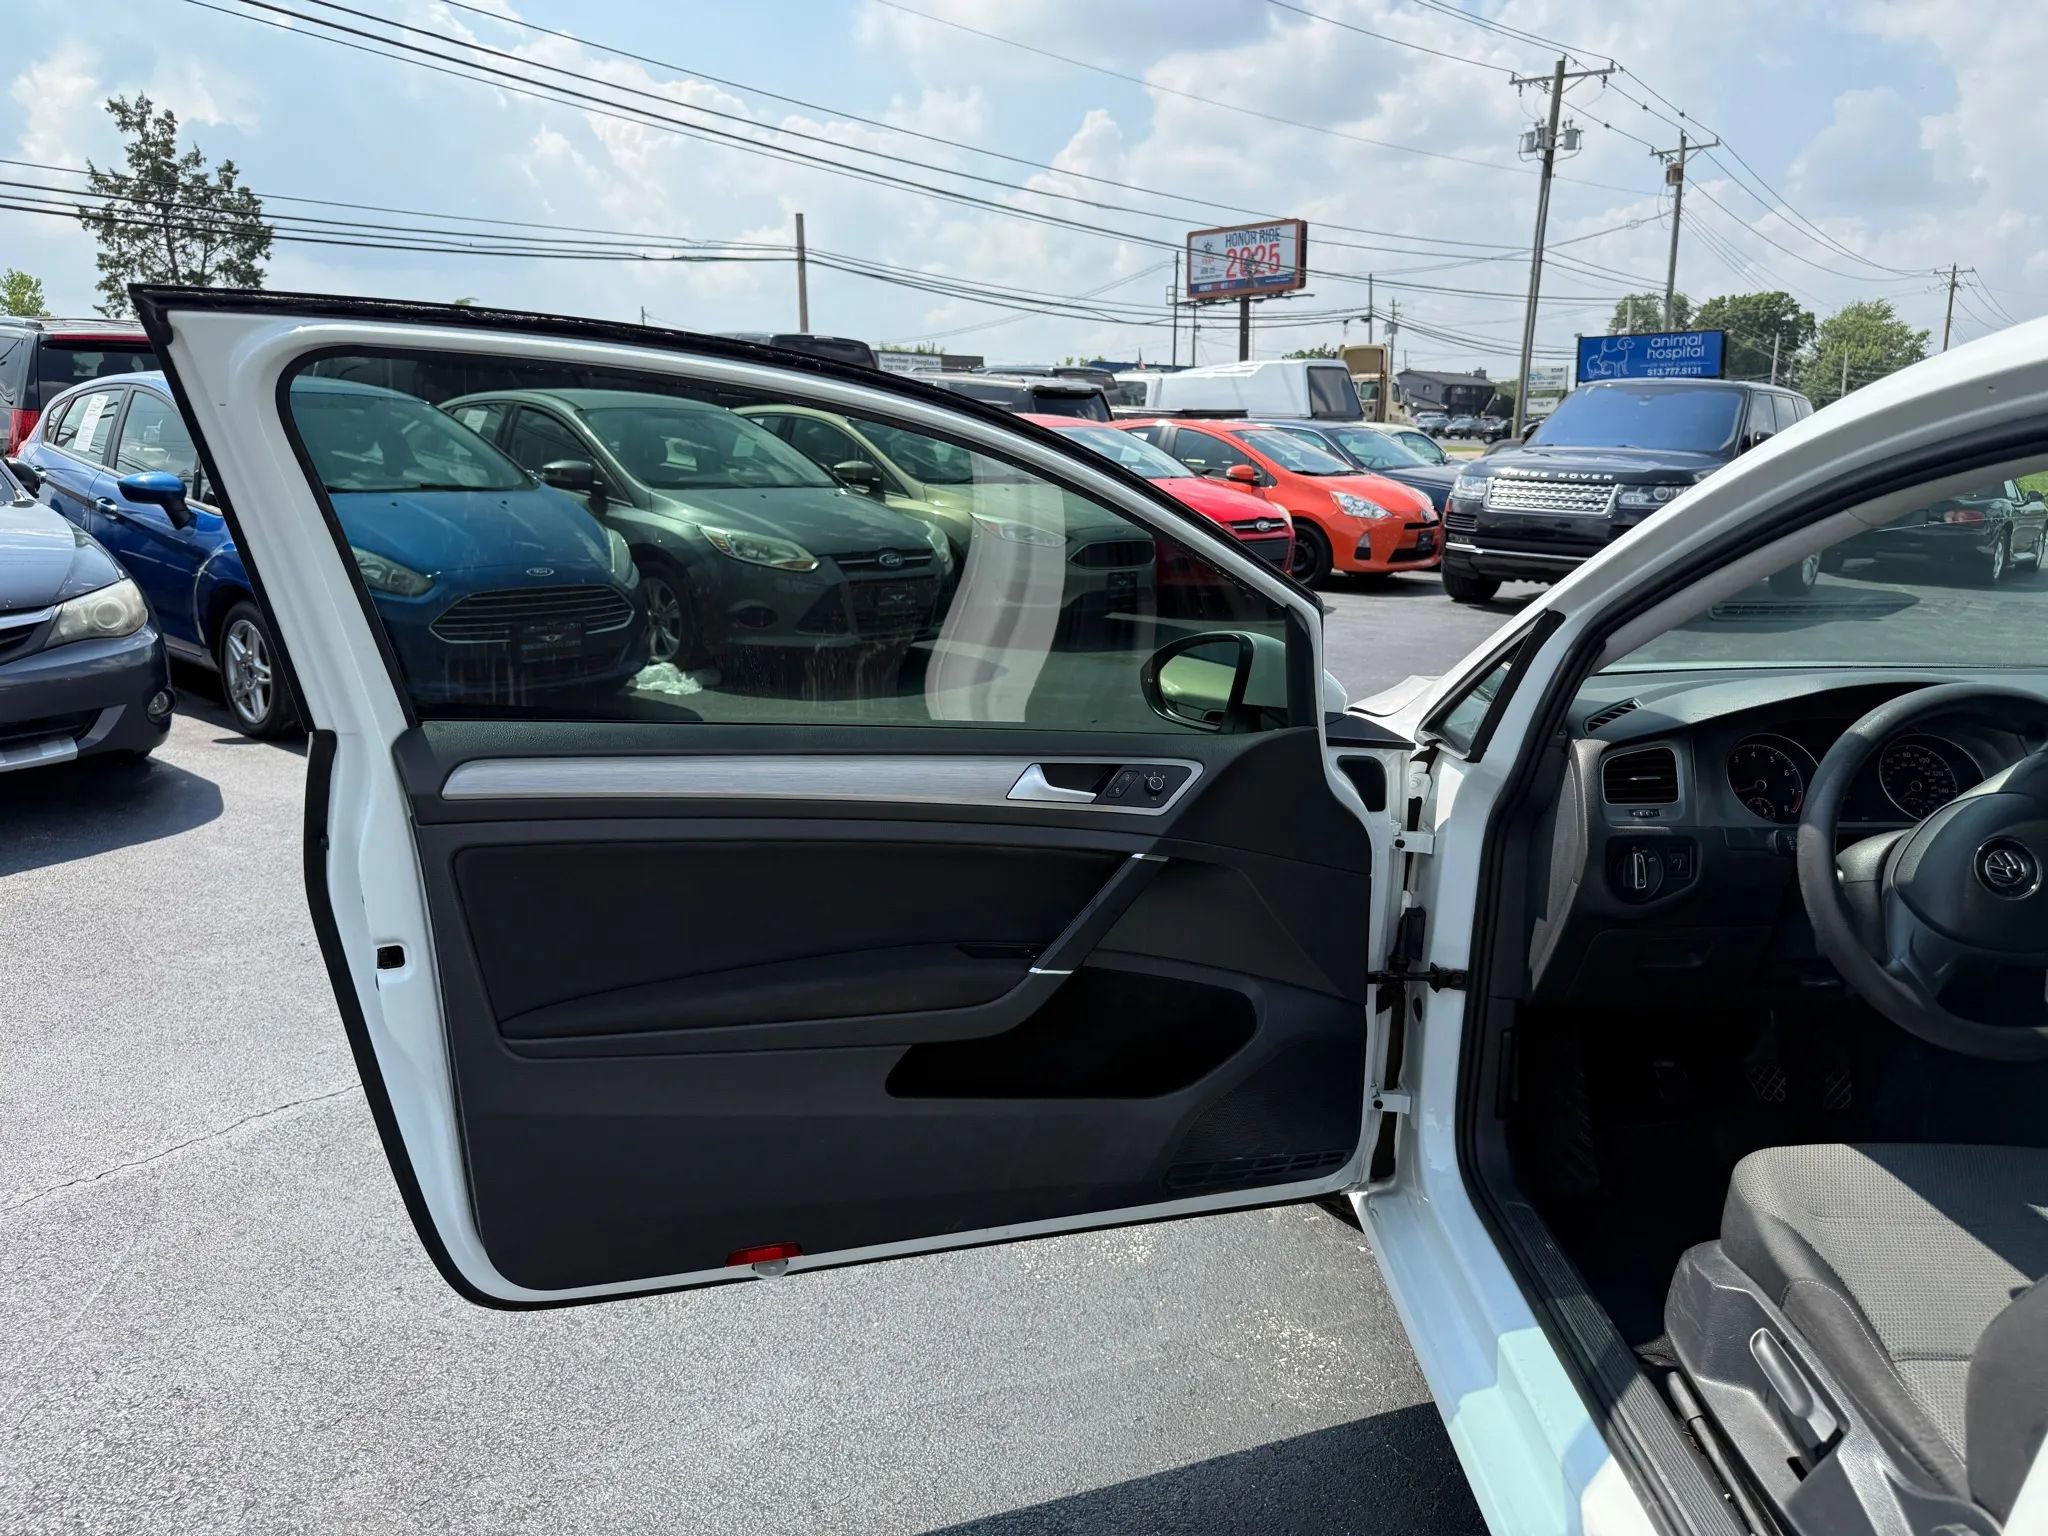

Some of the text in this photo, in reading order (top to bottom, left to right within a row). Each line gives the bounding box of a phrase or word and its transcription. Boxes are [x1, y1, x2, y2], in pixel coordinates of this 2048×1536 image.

[1225, 228, 1281, 247] HONOR RIDE
[1225, 243, 1281, 279] 2025
[1650, 333, 1703, 348] animal
[1646, 345, 1705, 360] hospital
[1557, 472, 1614, 480] ROVER
